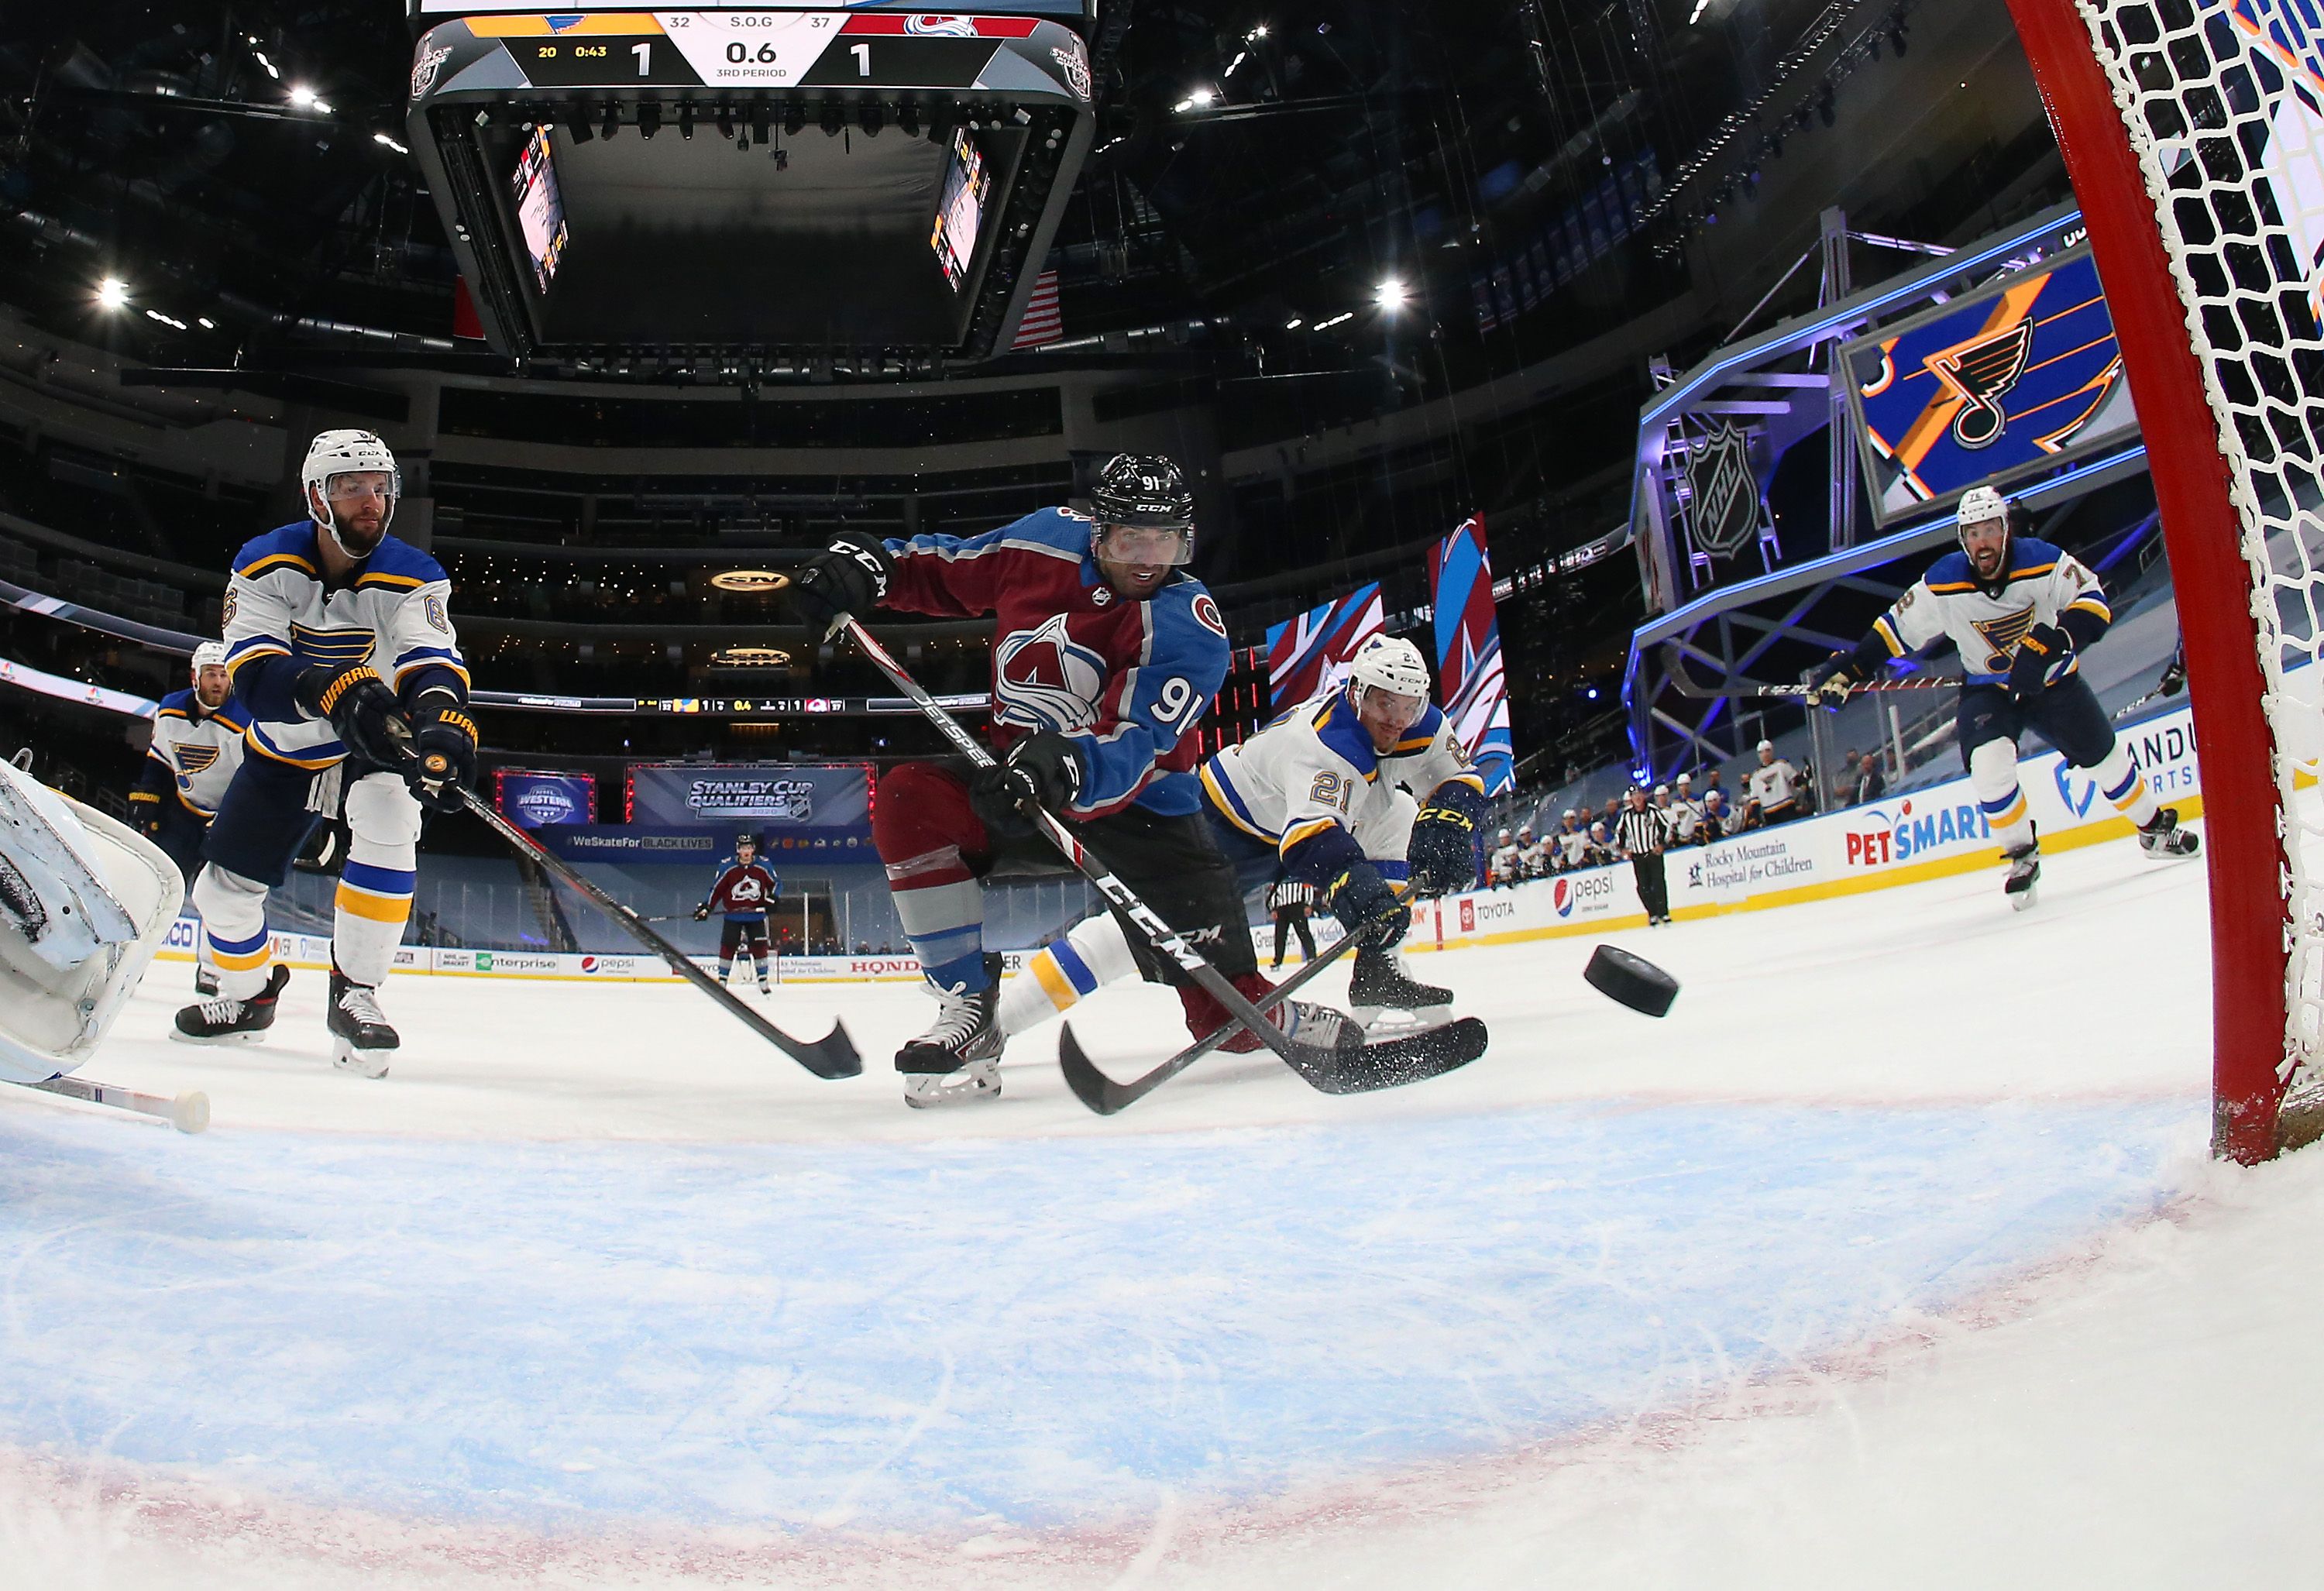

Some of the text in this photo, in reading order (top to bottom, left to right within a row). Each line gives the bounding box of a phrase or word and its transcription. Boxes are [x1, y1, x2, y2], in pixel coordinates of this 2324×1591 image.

[669, 17, 690, 28] 32
[731, 16, 772, 27] S.O.G
[811, 17, 830, 28] 37
[538, 46, 607, 57] 20 0:43
[631, 43, 651, 76] 1
[727, 43, 776, 64] 0.6
[851, 43, 870, 76] 1
[717, 69, 786, 77] 3RD PERIOD
[1142, 476, 1160, 490] 91
[1707, 459, 1737, 536] NHL
[829, 540, 886, 597] CCM
[222, 588, 237, 629] 6
[425, 594, 449, 634] 6
[1403, 653, 1417, 664] 21
[320, 665, 383, 715] WARRIO
[703, 700, 708, 711] 1
[734, 700, 751, 711] 0.4
[794, 700, 799, 711] 1
[1150, 677, 1204, 737] 91
[438, 710, 479, 752] WAR
[2127, 723, 2197, 770] ANDU
[691, 781, 813, 794] STANLEY CUP
[1310, 771, 1354, 814] 21
[519, 796, 572, 808] WESTERN
[688, 796, 785, 807] QUALIFIERS
[1416, 808, 1473, 832] CCM
[643, 838, 678, 848] BLACK
[681, 838, 711, 849] LIVES
[1705, 840, 1786, 868] Rocky Mountain
[1707, 858, 1813, 888] Hospital for Children
[1575, 871, 1614, 902] pepsi
[1478, 902, 1514, 920] TOYOTA
[1095, 871, 1206, 971] CCM
[167, 922, 192, 947] CO
[1255, 931, 1275, 948] Grea
[600, 958, 634, 970] pepsi
[852, 961, 920, 974] HOND
